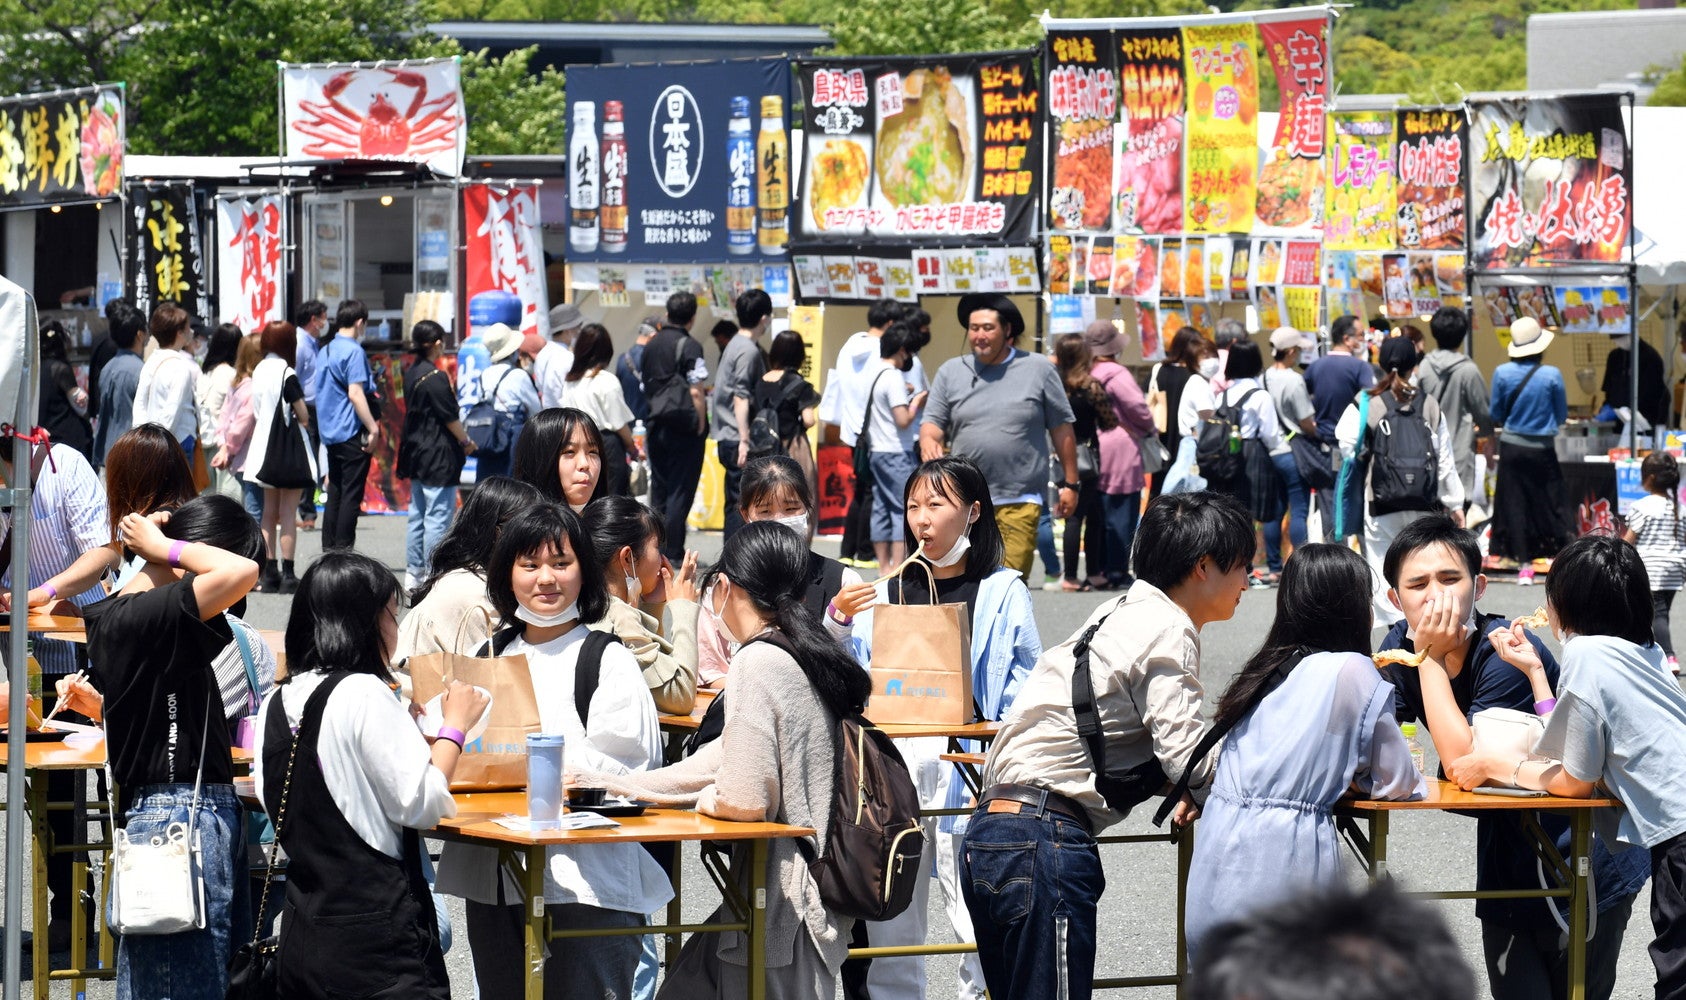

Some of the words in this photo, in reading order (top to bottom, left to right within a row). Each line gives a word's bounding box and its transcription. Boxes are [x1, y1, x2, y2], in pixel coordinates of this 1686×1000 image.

[813, 70, 867, 105] 鳥取県
[1287, 30, 1325, 157] 辛麺
[663, 92, 691, 188] 日本盛
[1400, 134, 1461, 187] いか焼き
[576, 145, 592, 188] 生
[603, 142, 624, 189] 生
[730, 140, 751, 188] 生
[763, 141, 781, 187] 生
[167, 692, 178, 720] SOON
[168, 722, 178, 751] LAND
